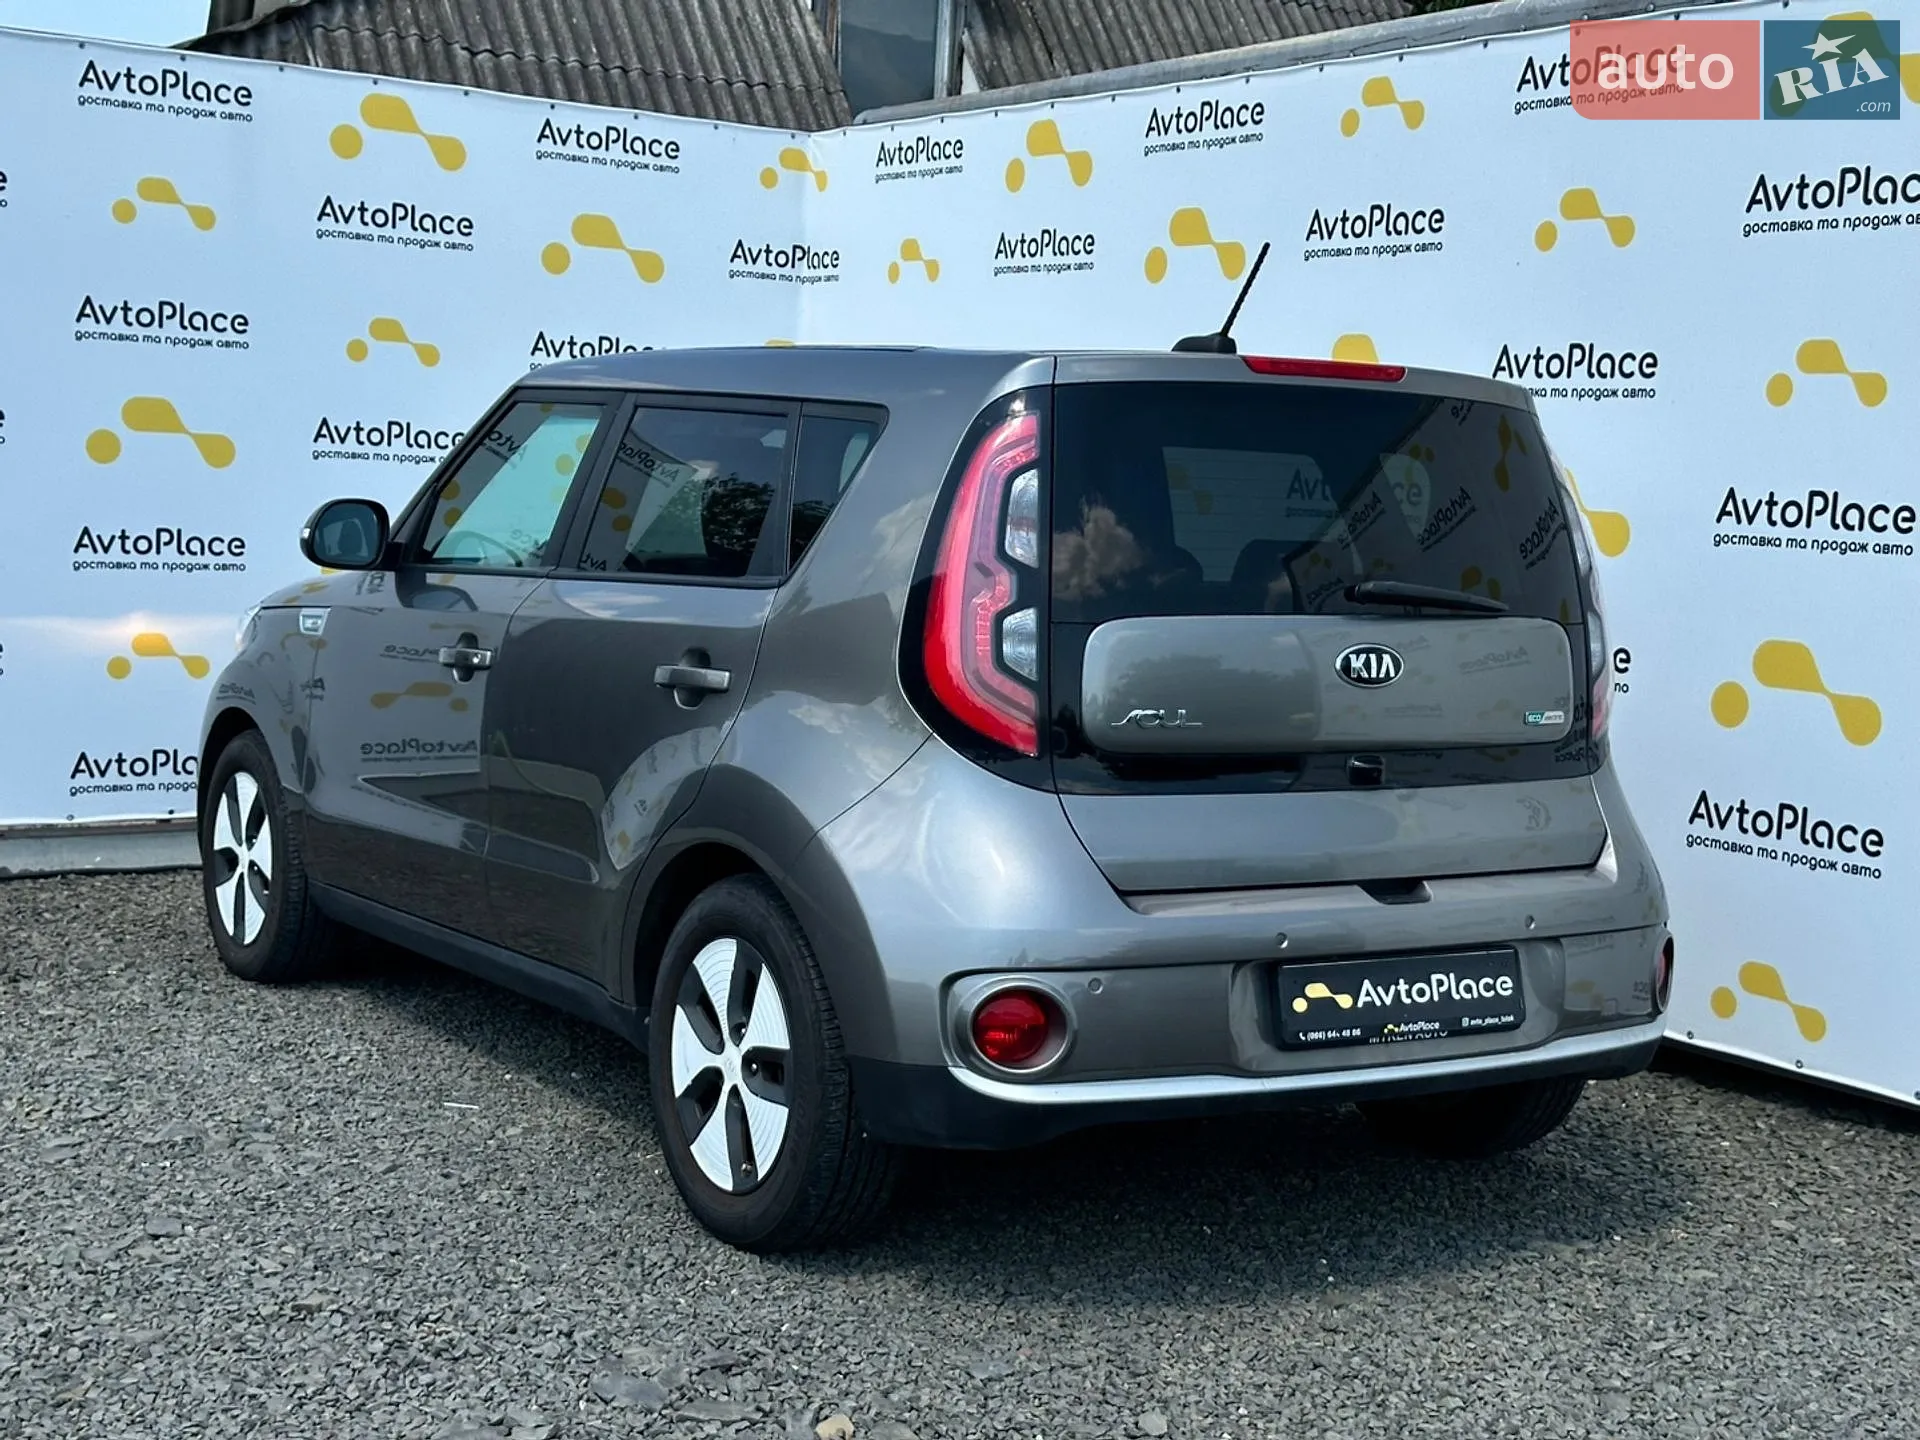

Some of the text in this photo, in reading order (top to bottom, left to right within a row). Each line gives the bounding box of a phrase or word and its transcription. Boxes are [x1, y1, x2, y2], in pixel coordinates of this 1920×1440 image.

[79, 60, 252, 106] AvtoPlace
[78, 95, 252, 122] доставка та продаж авто
[1514, 95, 1573, 115] доставка
[1576, 93, 1595, 105] та
[1597, 88, 1646, 105] продаж
[1145, 100, 1264, 138] AvtoPlace
[537, 118, 680, 159] AvtoPlace
[876, 136, 963, 168] AvtoPlace
[1144, 133, 1263, 156] доставка та продаж авто
[536, 151, 679, 173] доставка та продаж авто
[1746, 166, 1920, 213] AvtoPlac
[317, 195, 473, 237] AvtoPlace
[1306, 203, 1444, 241] AvtoPlace
[1743, 220, 1813, 237] доставка
[1817, 218, 1839, 230] та
[1843, 214, 1902, 231] продаж
[316, 229, 473, 251] доставка та продаж авто
[730, 239, 840, 270] AvtoPlace
[995, 229, 1095, 259] AvtoPlace
[1304, 242, 1443, 261] доставка та продаж авто
[729, 269, 777, 282] доставка
[779, 274, 793, 282] та
[76, 295, 249, 334] AvtoPlace
[75, 331, 249, 349] доставка та продаж авто
[1492, 342, 1658, 379] AvtoPlace
[1550, 388, 1568, 398] та
[1571, 388, 1619, 401] продаж
[1621, 388, 1656, 398] авто
[311, 450, 371, 460] доставка
[373, 452, 390, 461] та
[392, 452, 436, 465] продаж
[1716, 487, 1916, 534] AvtoPlace
[73, 526, 245, 557] AvtoPlace
[1713, 533, 1913, 556] доставка та продаж авто
[73, 561, 246, 572] доставка та продаж авто
[1349, 653, 1395, 678] KIA
[70, 749, 199, 779] AvtoPla
[69, 781, 198, 797] доставка та прода
[1689, 790, 1884, 857] AvtoPlace
[1686, 834, 1881, 879] доставка та продаж авто
[1357, 972, 1514, 1008] AvtoPlace
